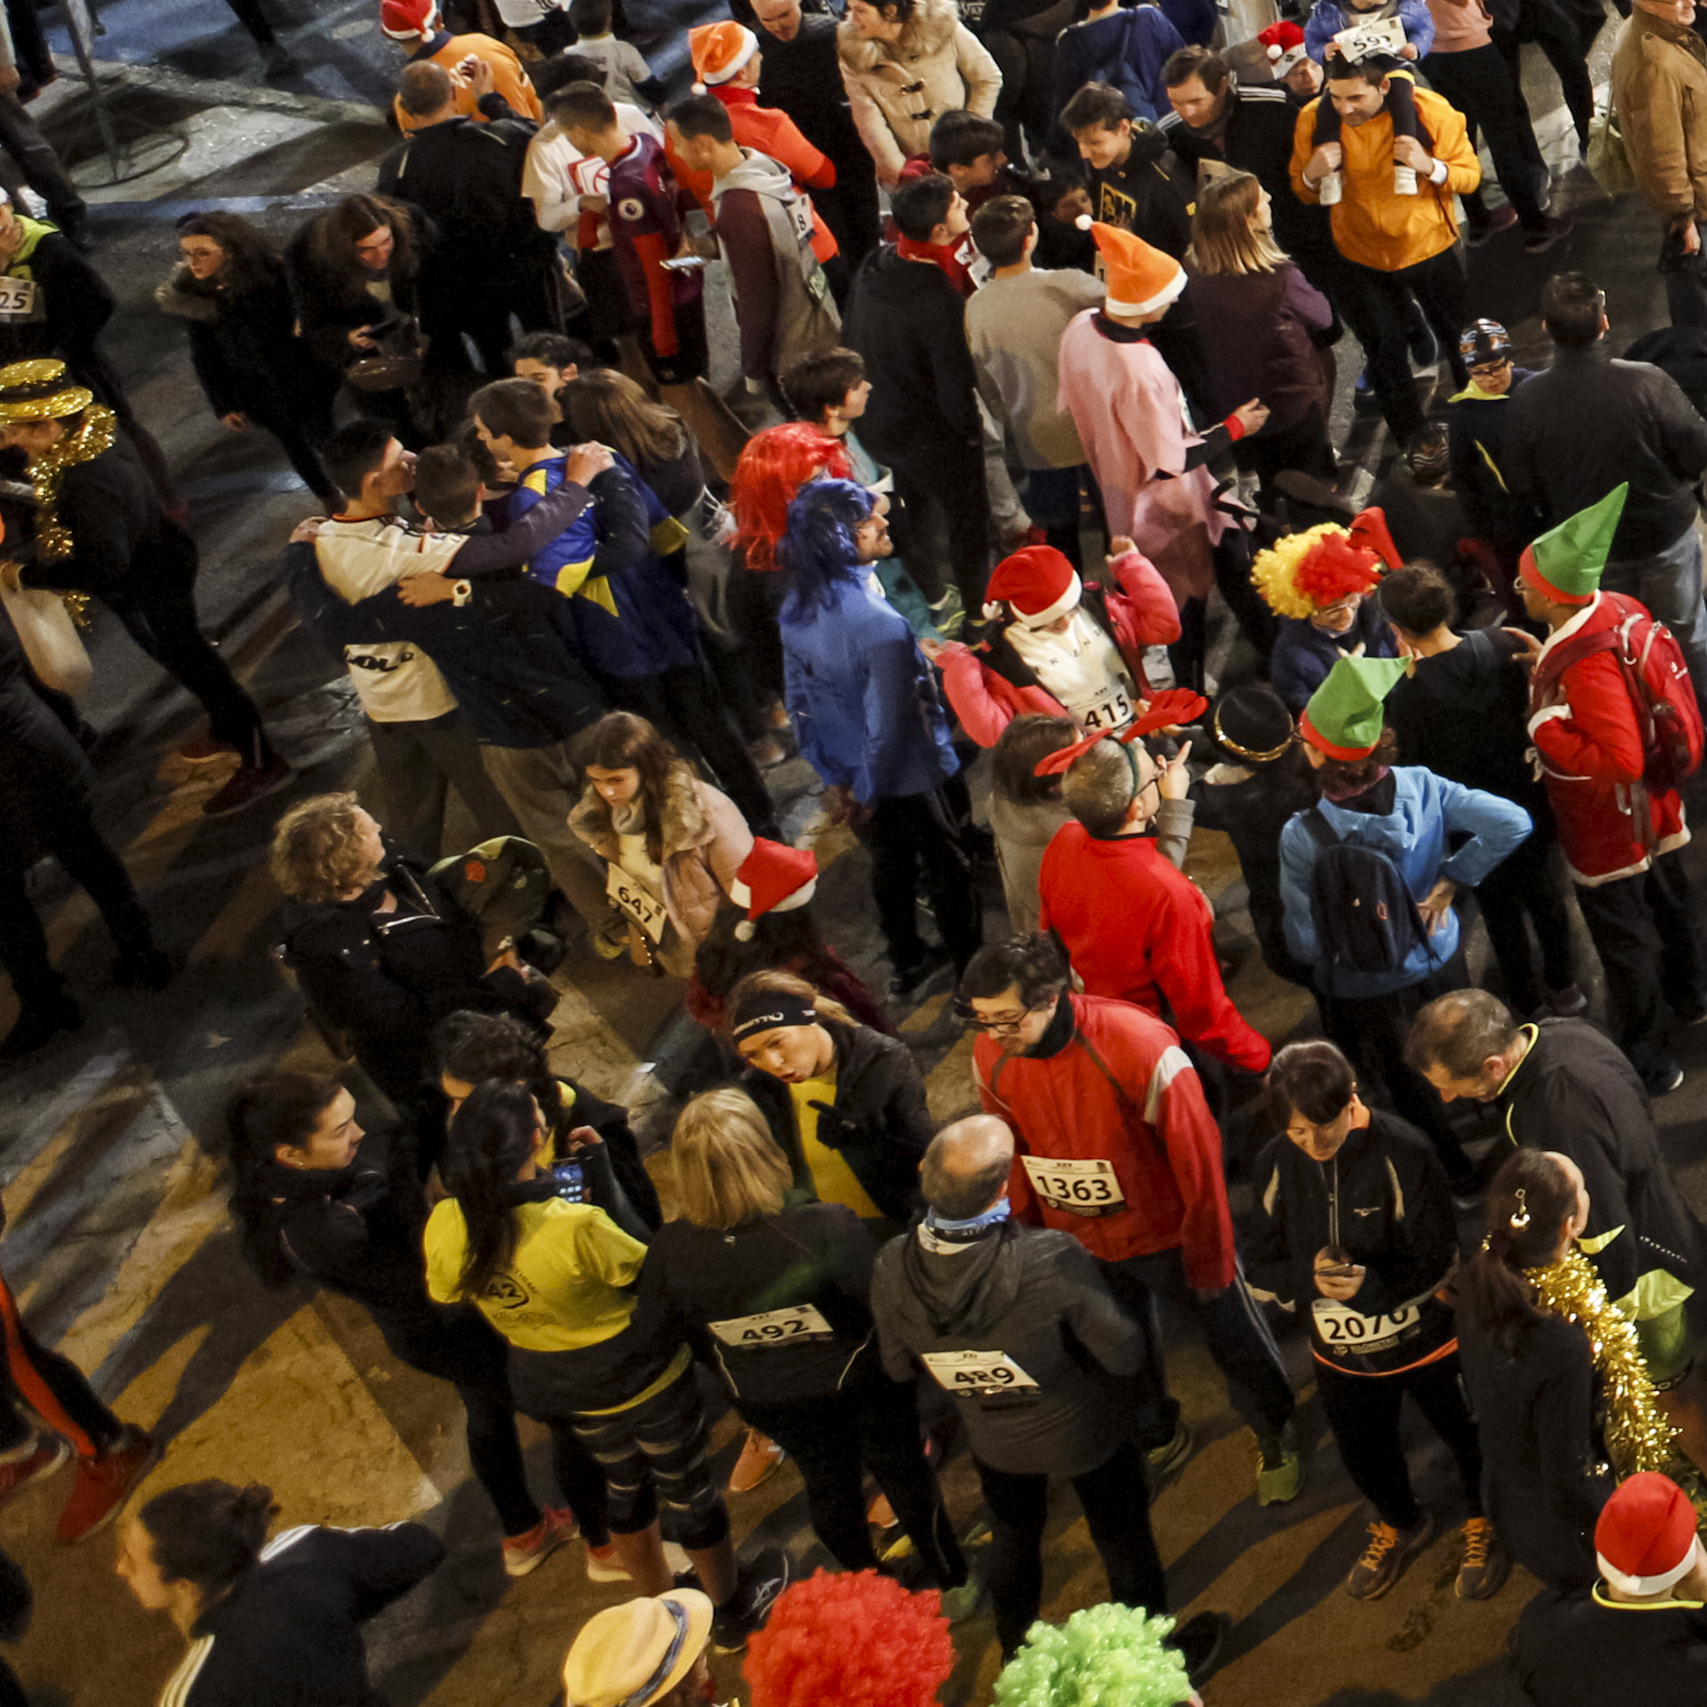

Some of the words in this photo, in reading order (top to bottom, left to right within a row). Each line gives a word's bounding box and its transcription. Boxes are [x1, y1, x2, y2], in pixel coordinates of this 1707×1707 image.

[1085, 694, 1129, 729] 415
[619, 886, 653, 924] 647
[1036, 1173, 1112, 1203] 1363
[742, 1318, 809, 1343] 492
